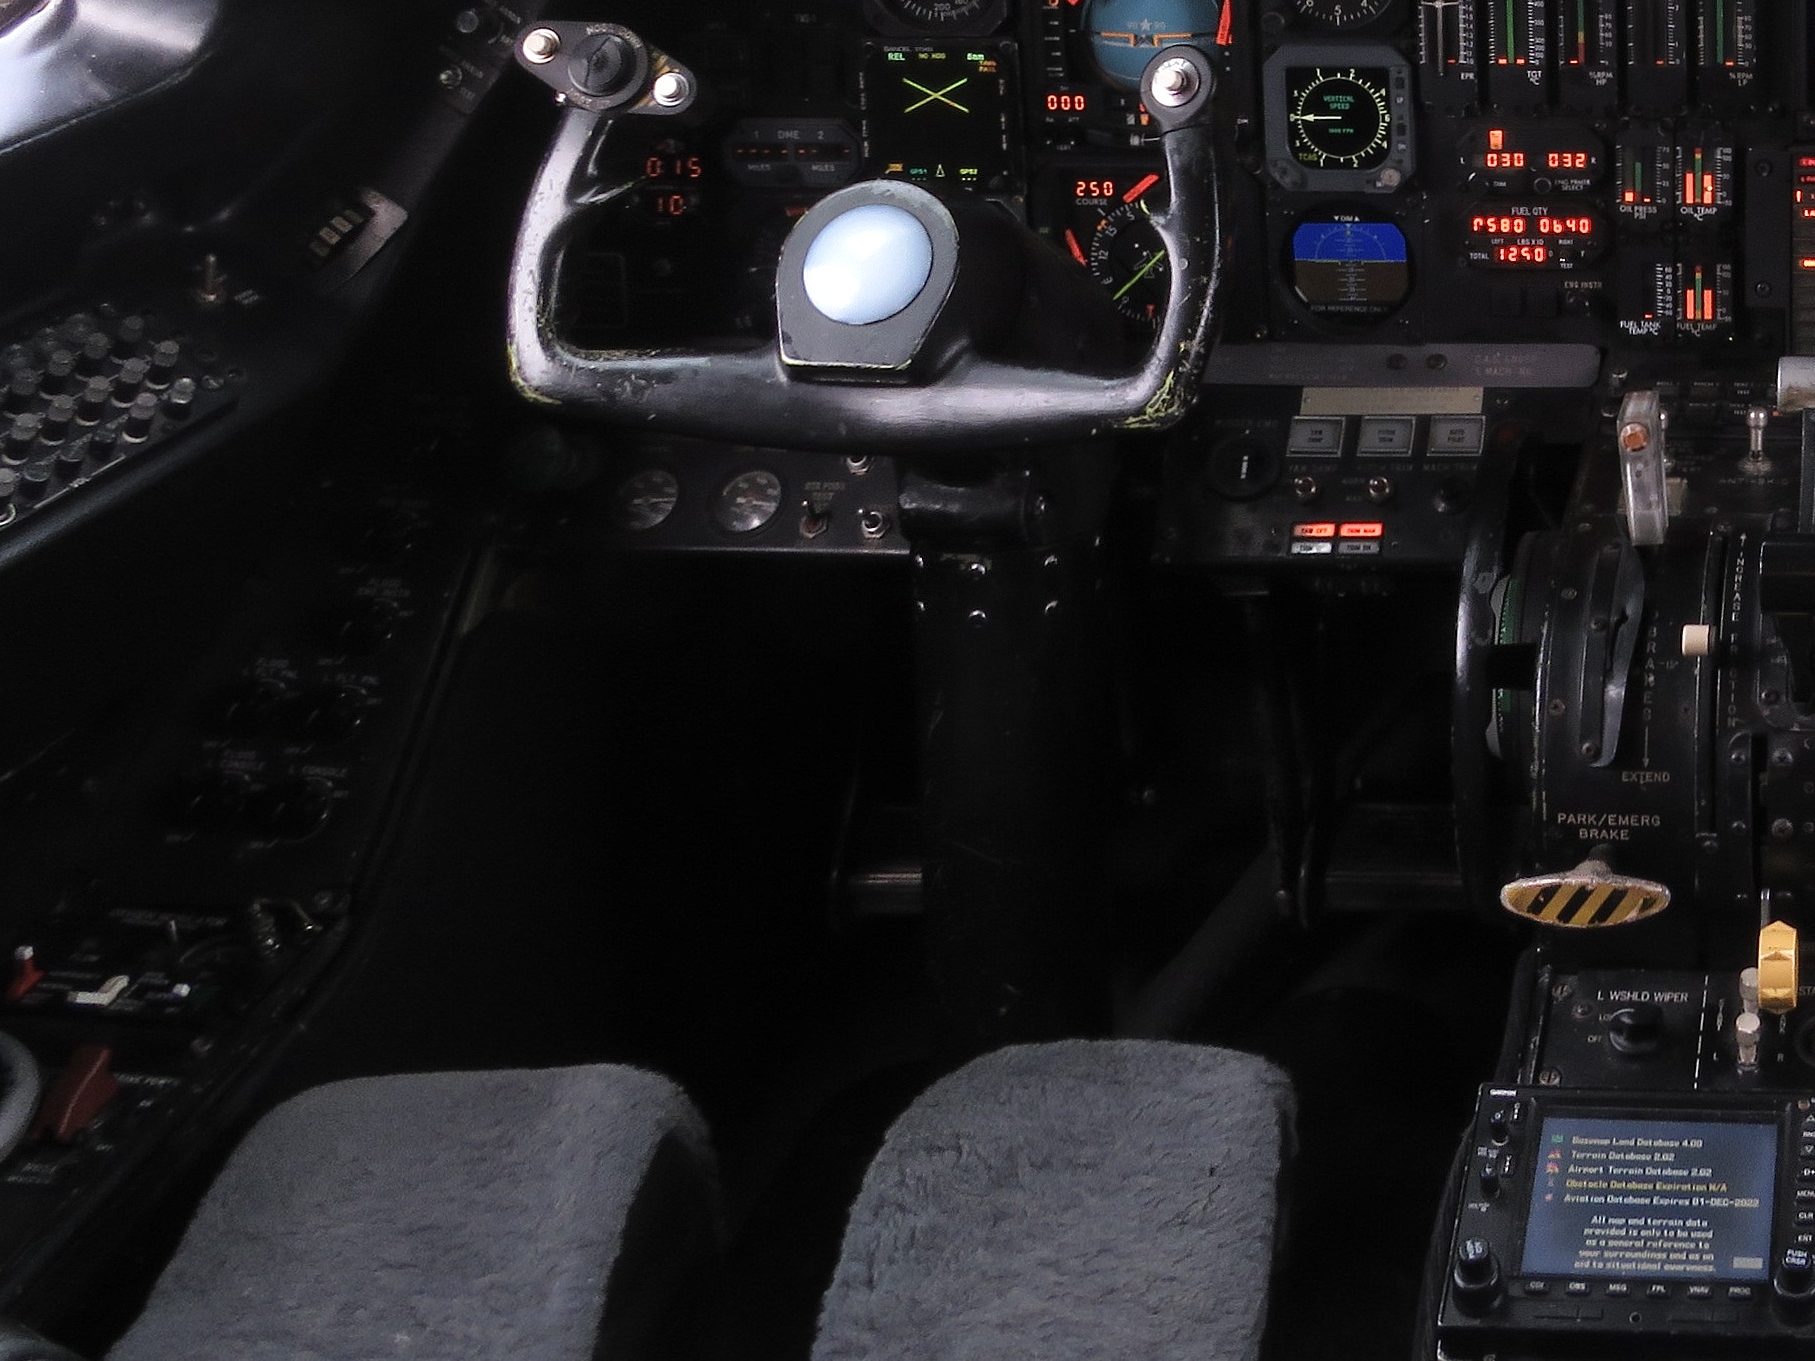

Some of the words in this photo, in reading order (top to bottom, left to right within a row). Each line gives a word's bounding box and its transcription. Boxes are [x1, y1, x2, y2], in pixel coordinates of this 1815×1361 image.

[888, 53, 905, 61] REL
[1047, 95, 1086, 111] 000
[1486, 153, 1524, 168] 030
[1548, 153, 1586, 168] 032
[1076, 181, 1114, 197] 250
[1512, 207, 1531, 216] FUEL
[1533, 207, 1548, 216] QTY
[1635, 206, 1657, 214] PRESS
[1680, 207, 1694, 215] OIL
[1695, 207, 1717, 215] TEMP
[1634, 212, 1647, 220] PSI
[1470, 252, 1489, 260] TOTAL
[1620, 321, 1639, 329] FUEL
[1641, 321, 1660, 329] TANK
[1677, 322, 1695, 330] FUEL
[1697, 322, 1717, 330] TEMP
[1622, 772, 1670, 783] EXTEND
[1557, 814, 1660, 827] PARK/EMERG
[1579, 829, 1629, 841] BRAKE
[1597, 991, 1604, 1001] L
[1609, 991, 1650, 1002] WSHLD
[1654, 992, 1688, 1003] WIPER
